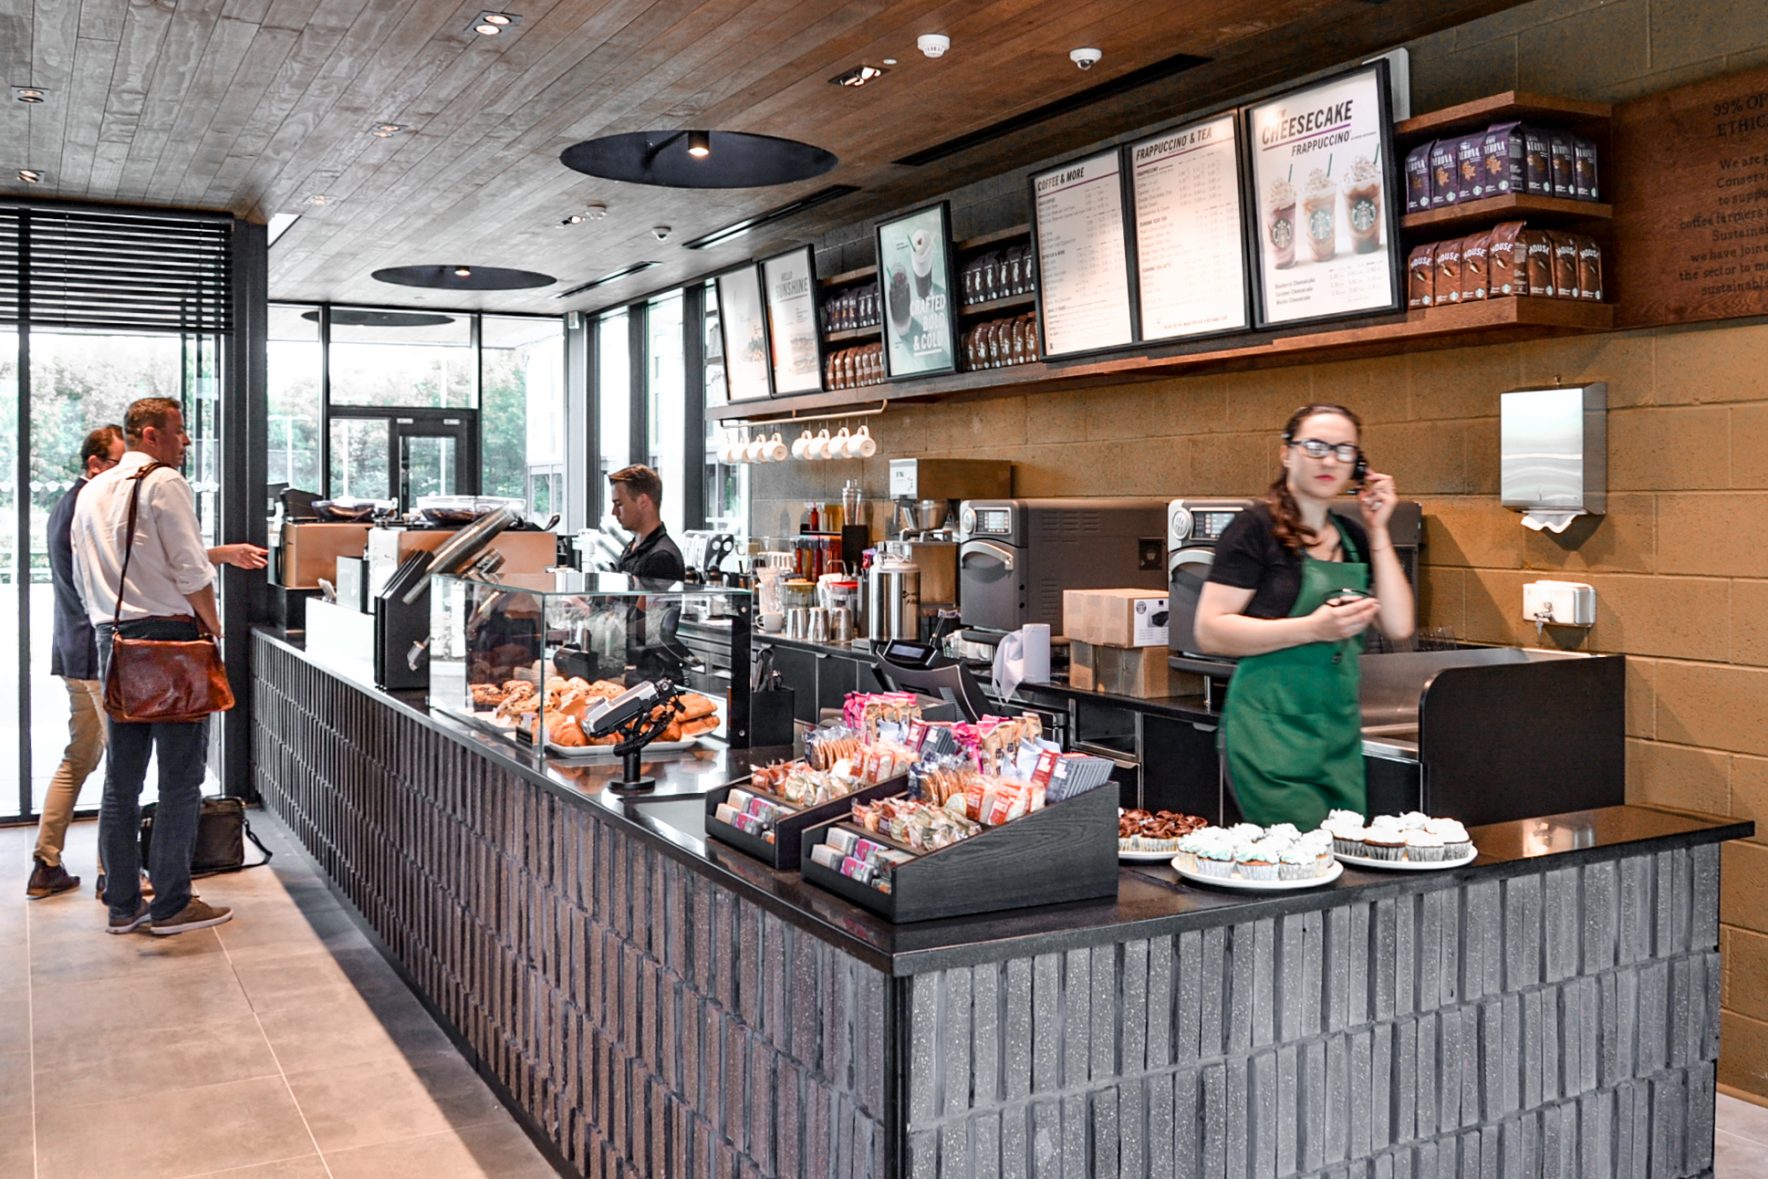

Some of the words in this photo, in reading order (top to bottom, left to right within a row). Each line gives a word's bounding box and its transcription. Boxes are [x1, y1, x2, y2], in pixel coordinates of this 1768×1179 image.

[1713, 98, 1743, 117] 99%
[1746, 93, 1768, 109] OF
[1261, 99, 1354, 145] CHEESECAKE
[1716, 114, 1768, 137] ETHIC
[1136, 135, 1187, 162] FRAPPUCCINO
[1189, 132, 1195, 144] &
[1197, 127, 1212, 142] TEA
[1291, 130, 1351, 157] FRAPPUCCINO
[1719, 157, 1739, 170] We
[1037, 175, 1059, 192] COFFEE
[1060, 174, 1065, 184] &
[1066, 166, 1085, 182] MORE
[1716, 172, 1768, 189] Conserv
[1718, 195, 1730, 206] to
[1716, 208, 1763, 225] farmers
[1463, 247, 1487, 260] HOUSE
[1490, 242, 1513, 254] HOUSE
[1709, 248, 1737, 261] have
[1680, 269, 1698, 281] the
[1739, 262, 1751, 273] to
[775, 276, 809, 299] SUNSHINE
[910, 294, 946, 316] CRAFTED
[923, 312, 945, 331] BOLD
[913, 335, 920, 351] &
[921, 331, 943, 349] COLD
